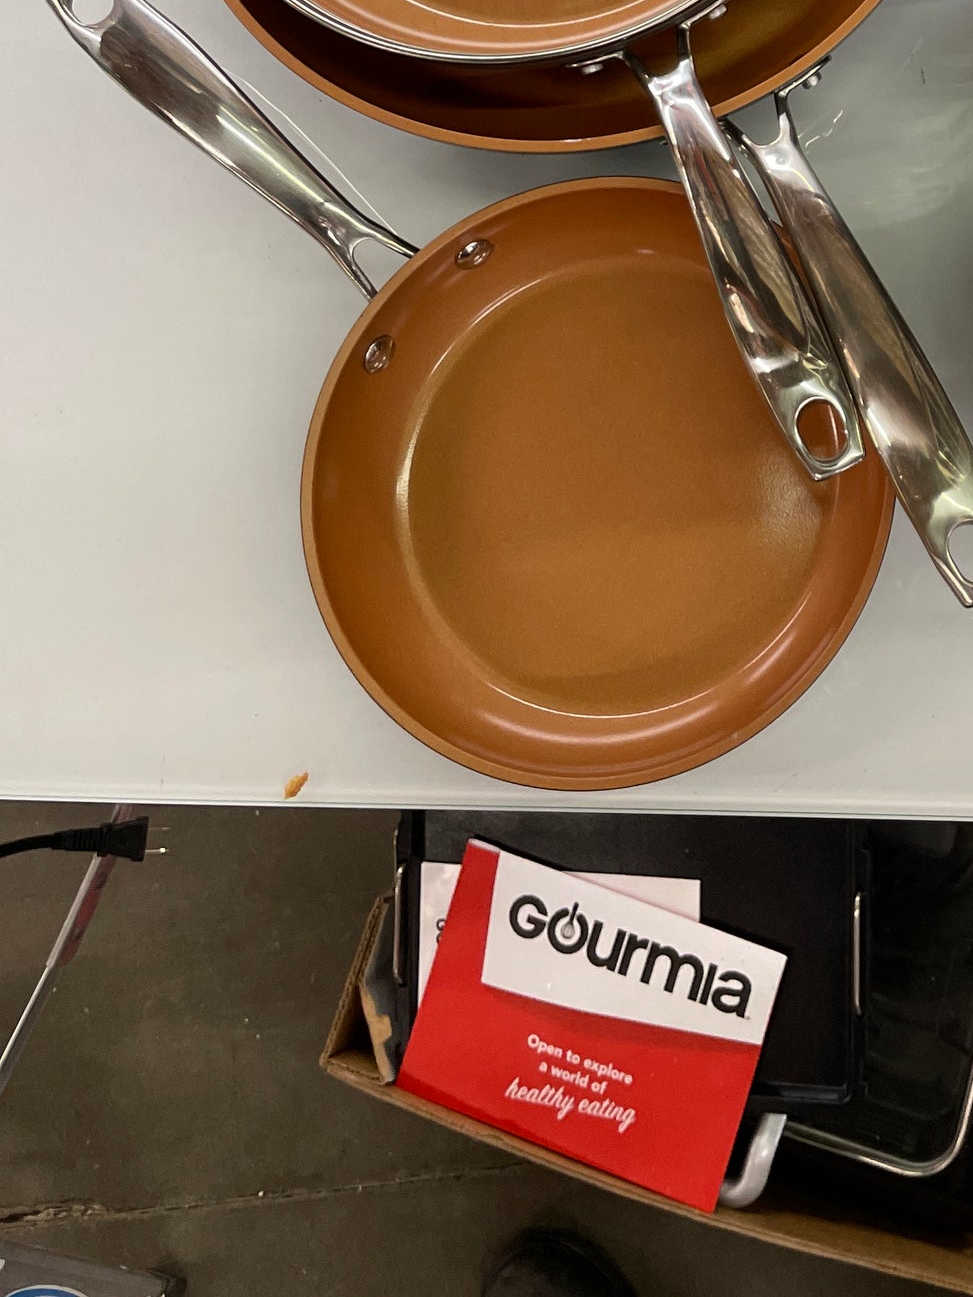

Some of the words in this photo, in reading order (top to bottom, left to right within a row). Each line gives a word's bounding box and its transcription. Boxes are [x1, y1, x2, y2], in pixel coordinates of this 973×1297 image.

[508, 893, 753, 1019] Gourmia
[527, 1033, 563, 1060] Open
[566, 1049, 581, 1066] to
[583, 1056, 633, 1086] explore
[538, 1062, 548, 1073] a
[551, 1063, 589, 1088] world
[590, 1080, 609, 1096] of
[504, 1077, 576, 1121] healthy
[576, 1095, 637, 1135] eating
